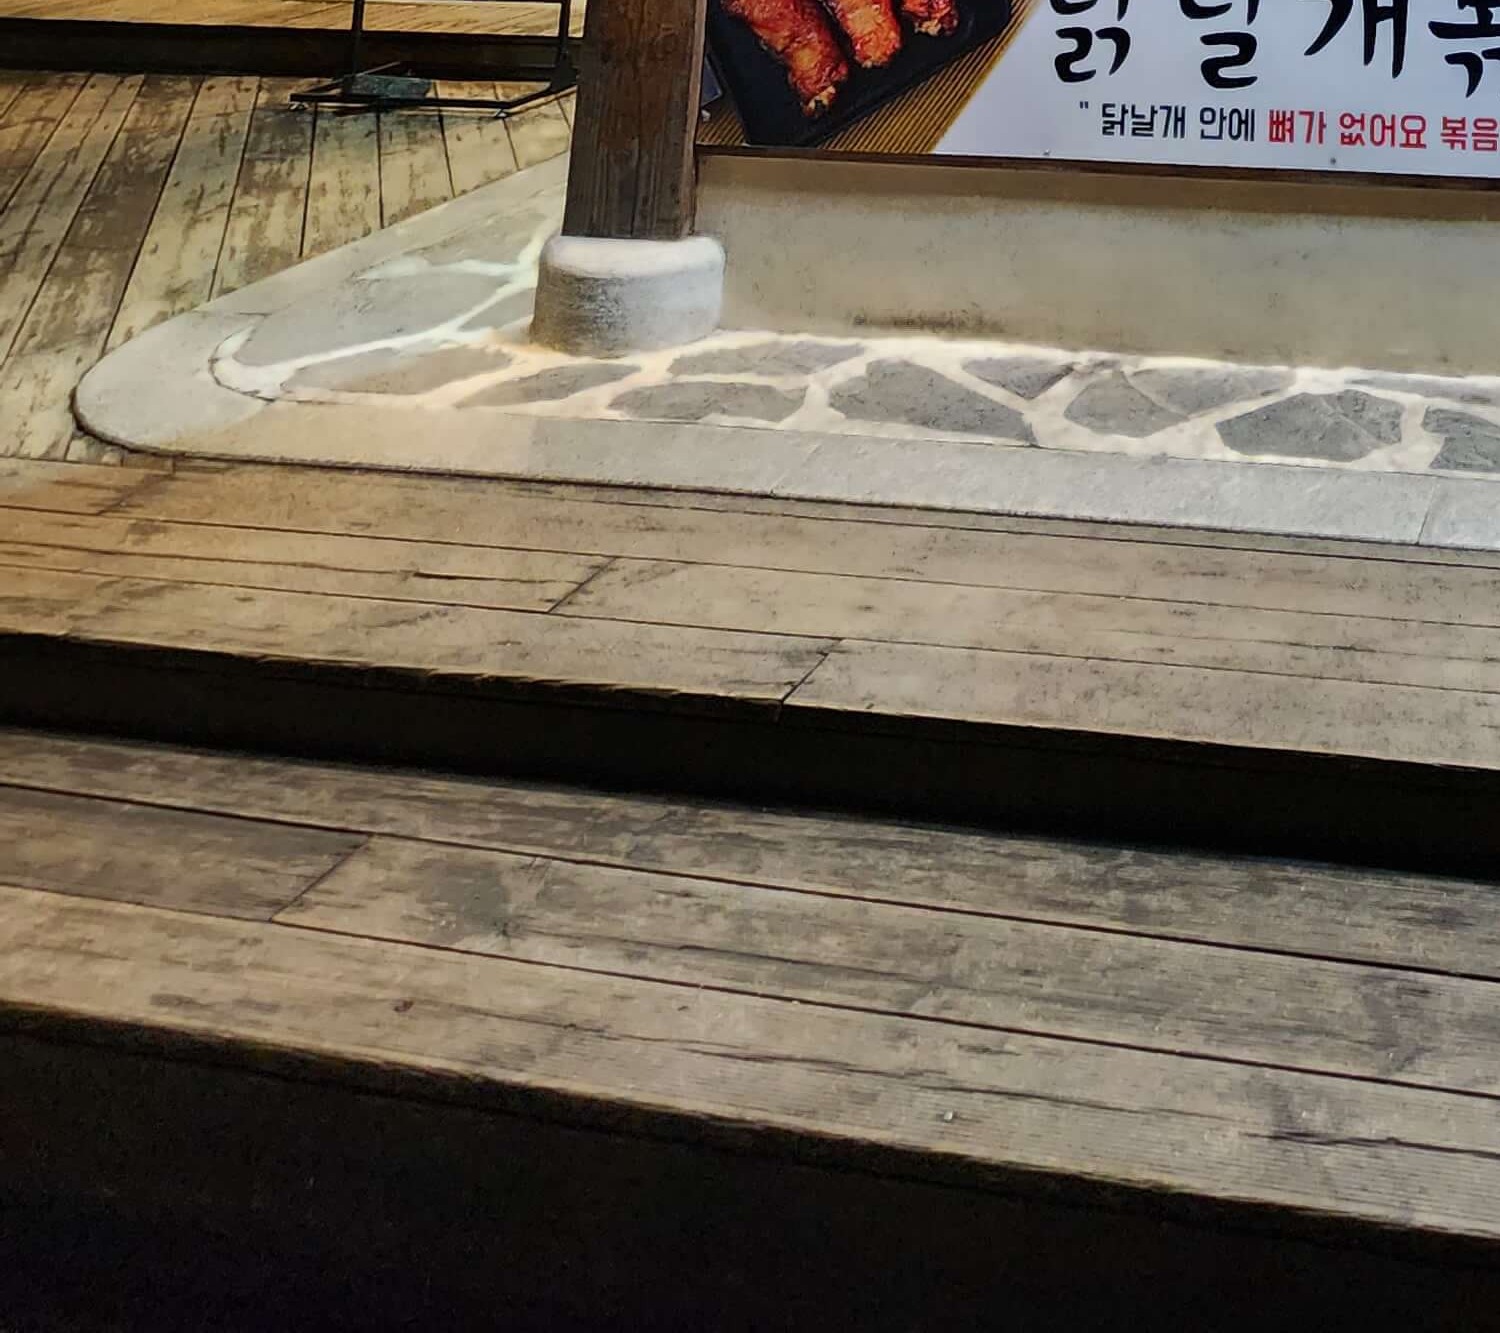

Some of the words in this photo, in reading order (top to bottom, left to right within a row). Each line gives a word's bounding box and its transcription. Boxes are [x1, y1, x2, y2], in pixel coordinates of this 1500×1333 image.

[1101, 102, 1187, 139] 닭날개
[1199, 106, 1255, 142] 안에
[1267, 109, 1327, 145] 뼈가
[1339, 112, 1428, 150] 없어요
